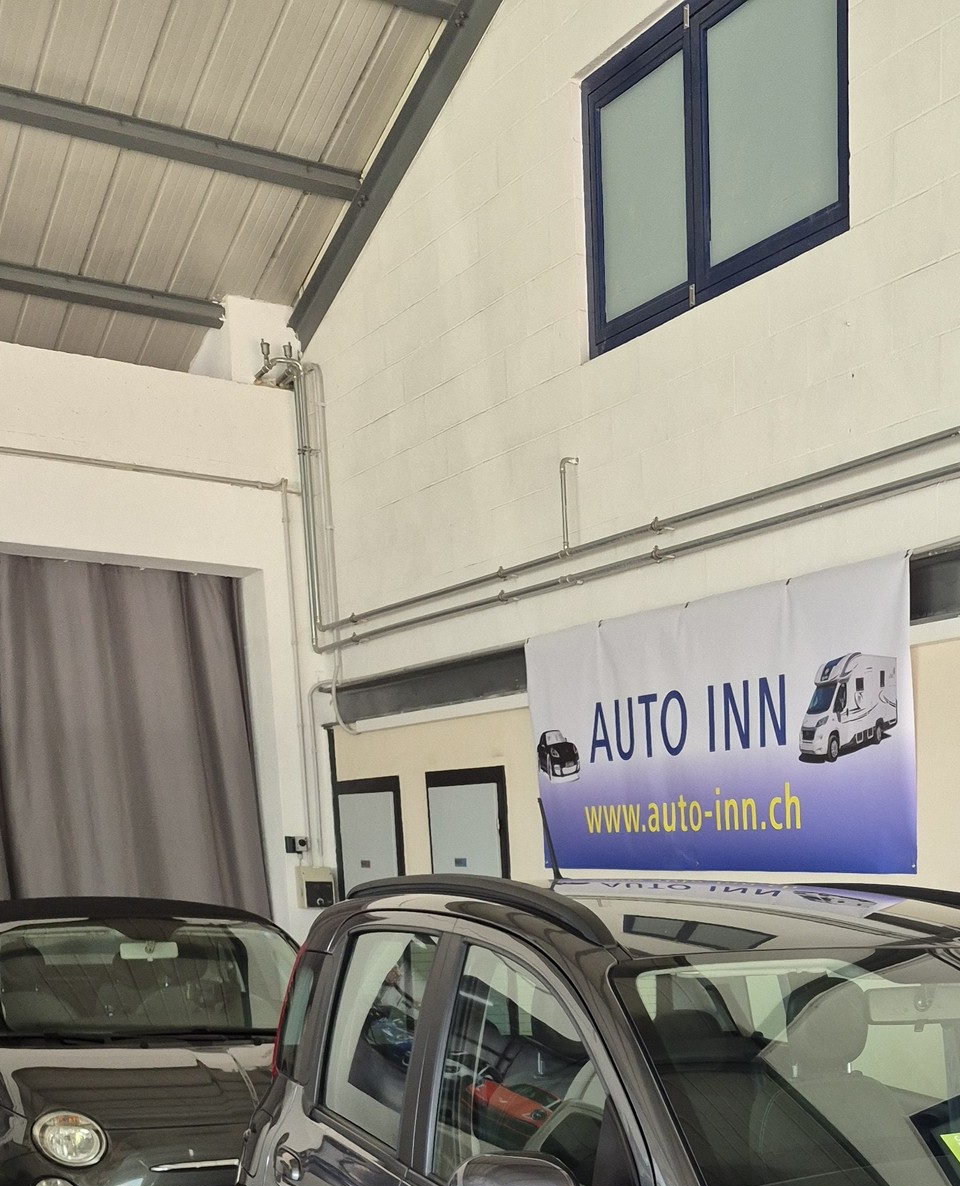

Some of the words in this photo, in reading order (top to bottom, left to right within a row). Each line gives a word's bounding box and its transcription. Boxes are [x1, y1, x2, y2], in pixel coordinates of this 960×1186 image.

[589, 690, 688, 763] AUTO
[707, 674, 788, 752] INN
[584, 780, 801, 834] www.auto-inn.ch
